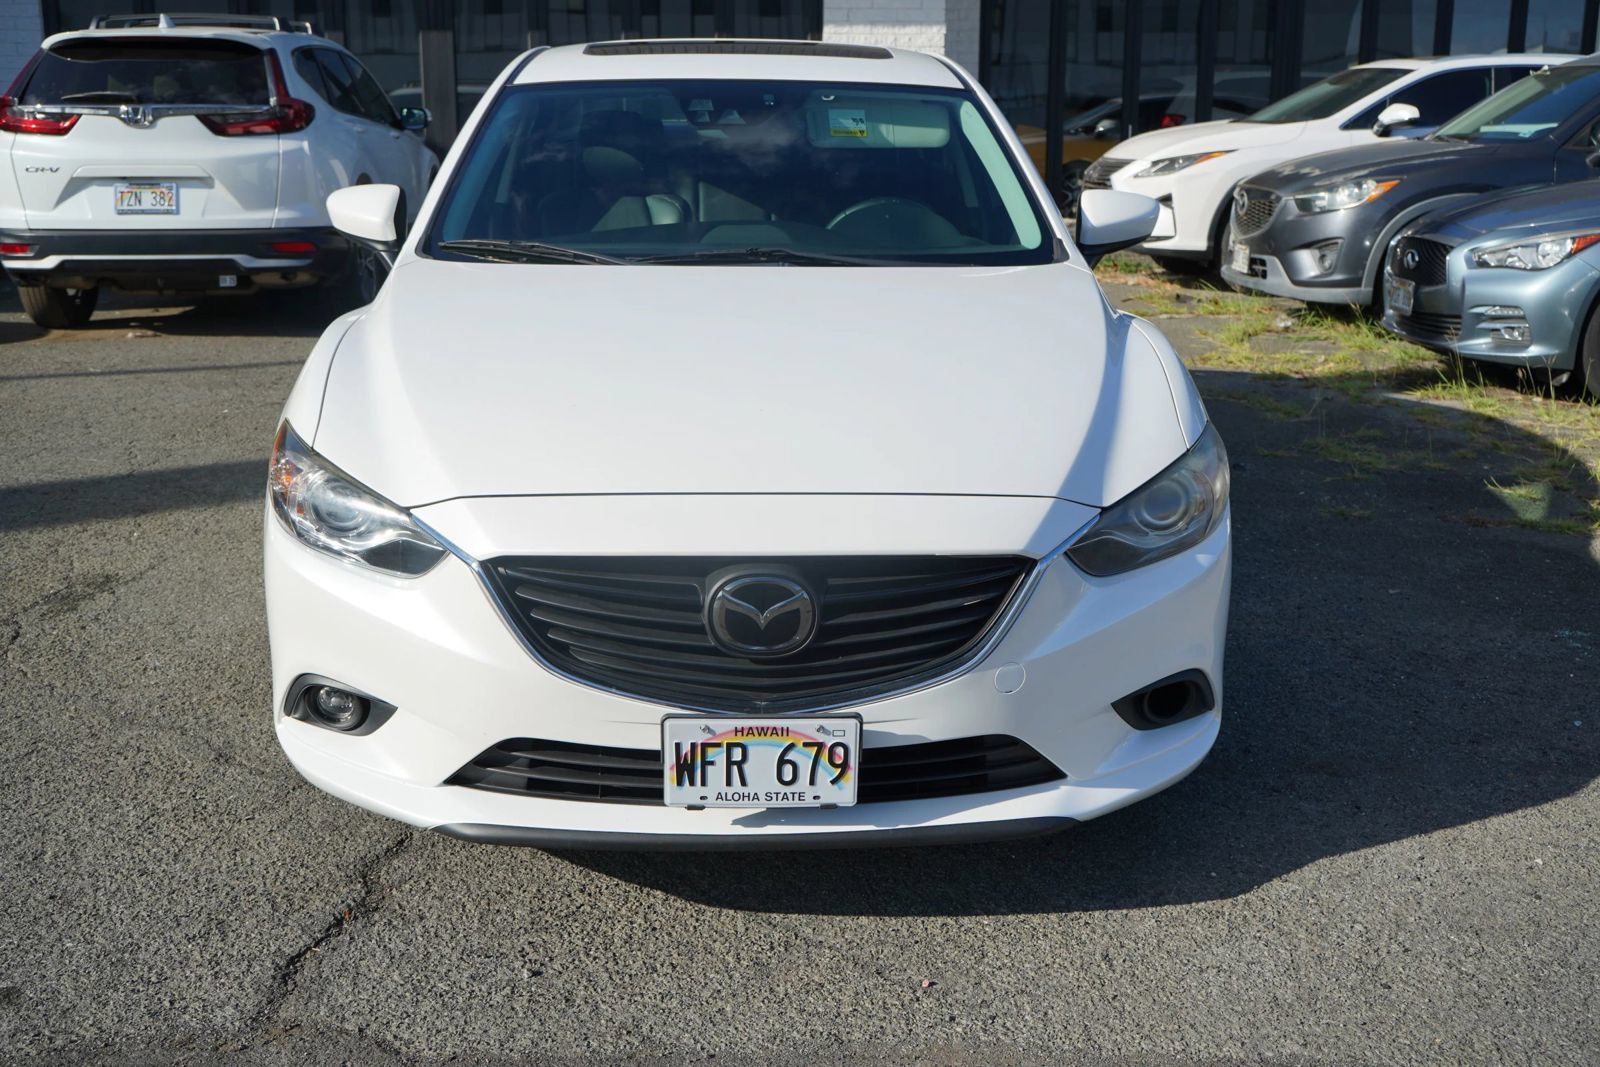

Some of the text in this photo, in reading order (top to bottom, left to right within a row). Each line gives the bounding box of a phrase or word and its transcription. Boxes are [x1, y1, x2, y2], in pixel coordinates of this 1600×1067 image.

[151, 190, 174, 206] 382
[734, 726, 790, 737] HAWAII
[674, 741, 849, 787] WFR 679
[715, 791, 806, 802] ALOHA STATE
